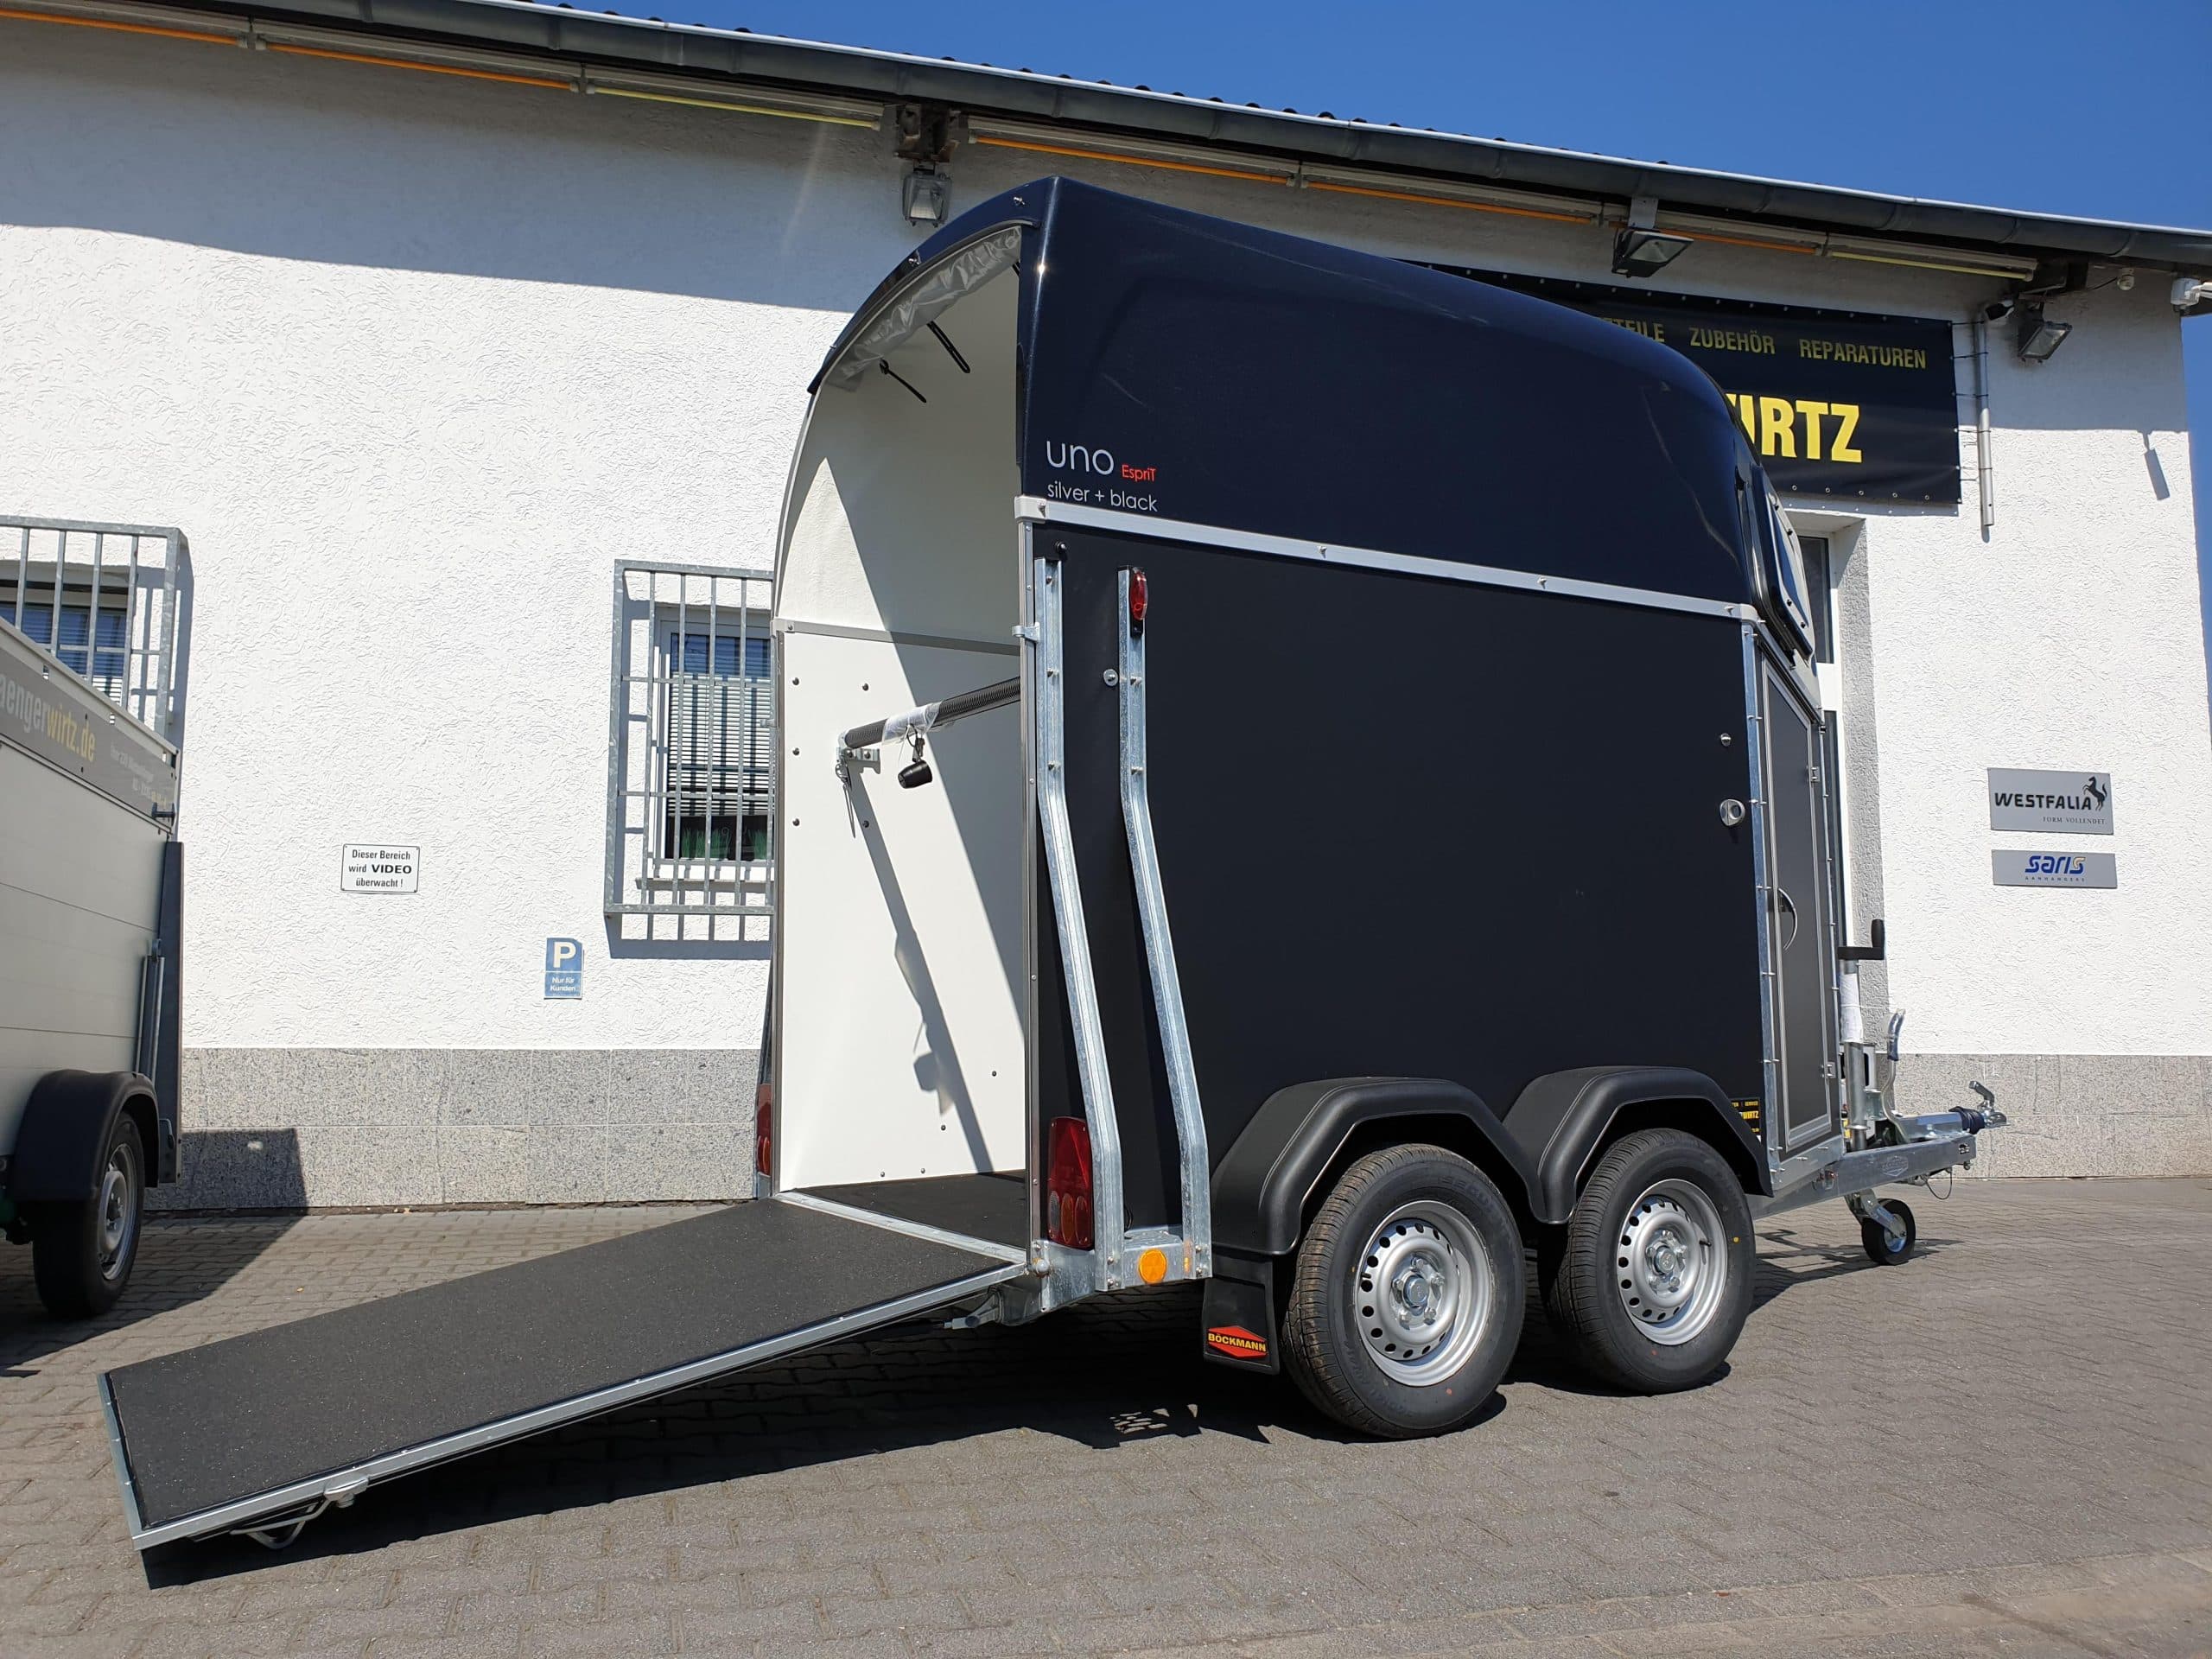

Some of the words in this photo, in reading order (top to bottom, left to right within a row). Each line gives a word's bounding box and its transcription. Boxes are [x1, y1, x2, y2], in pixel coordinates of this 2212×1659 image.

[1689, 327, 1776, 354] ZUBEHÖR
[1799, 338, 1926, 369] REPARATUREN
[1726, 393, 1862, 463] IRTZ
[1046, 441, 1115, 475] uno
[1047, 480, 1090, 502] silver
[1095, 490, 1105, 502] +
[1110, 489, 1158, 512] black
[1994, 792, 2092, 810] WESTFALIA
[352, 849, 378, 859] Dieser
[379, 849, 410, 860] Bereich
[2024, 855, 2086, 874] saris
[348, 864, 367, 873] wird
[372, 864, 412, 874] VIDEO
[355, 878, 398, 887] überwacht
[553, 941, 576, 969] P
[1208, 1332, 1267, 1352] BÖCKMANN
